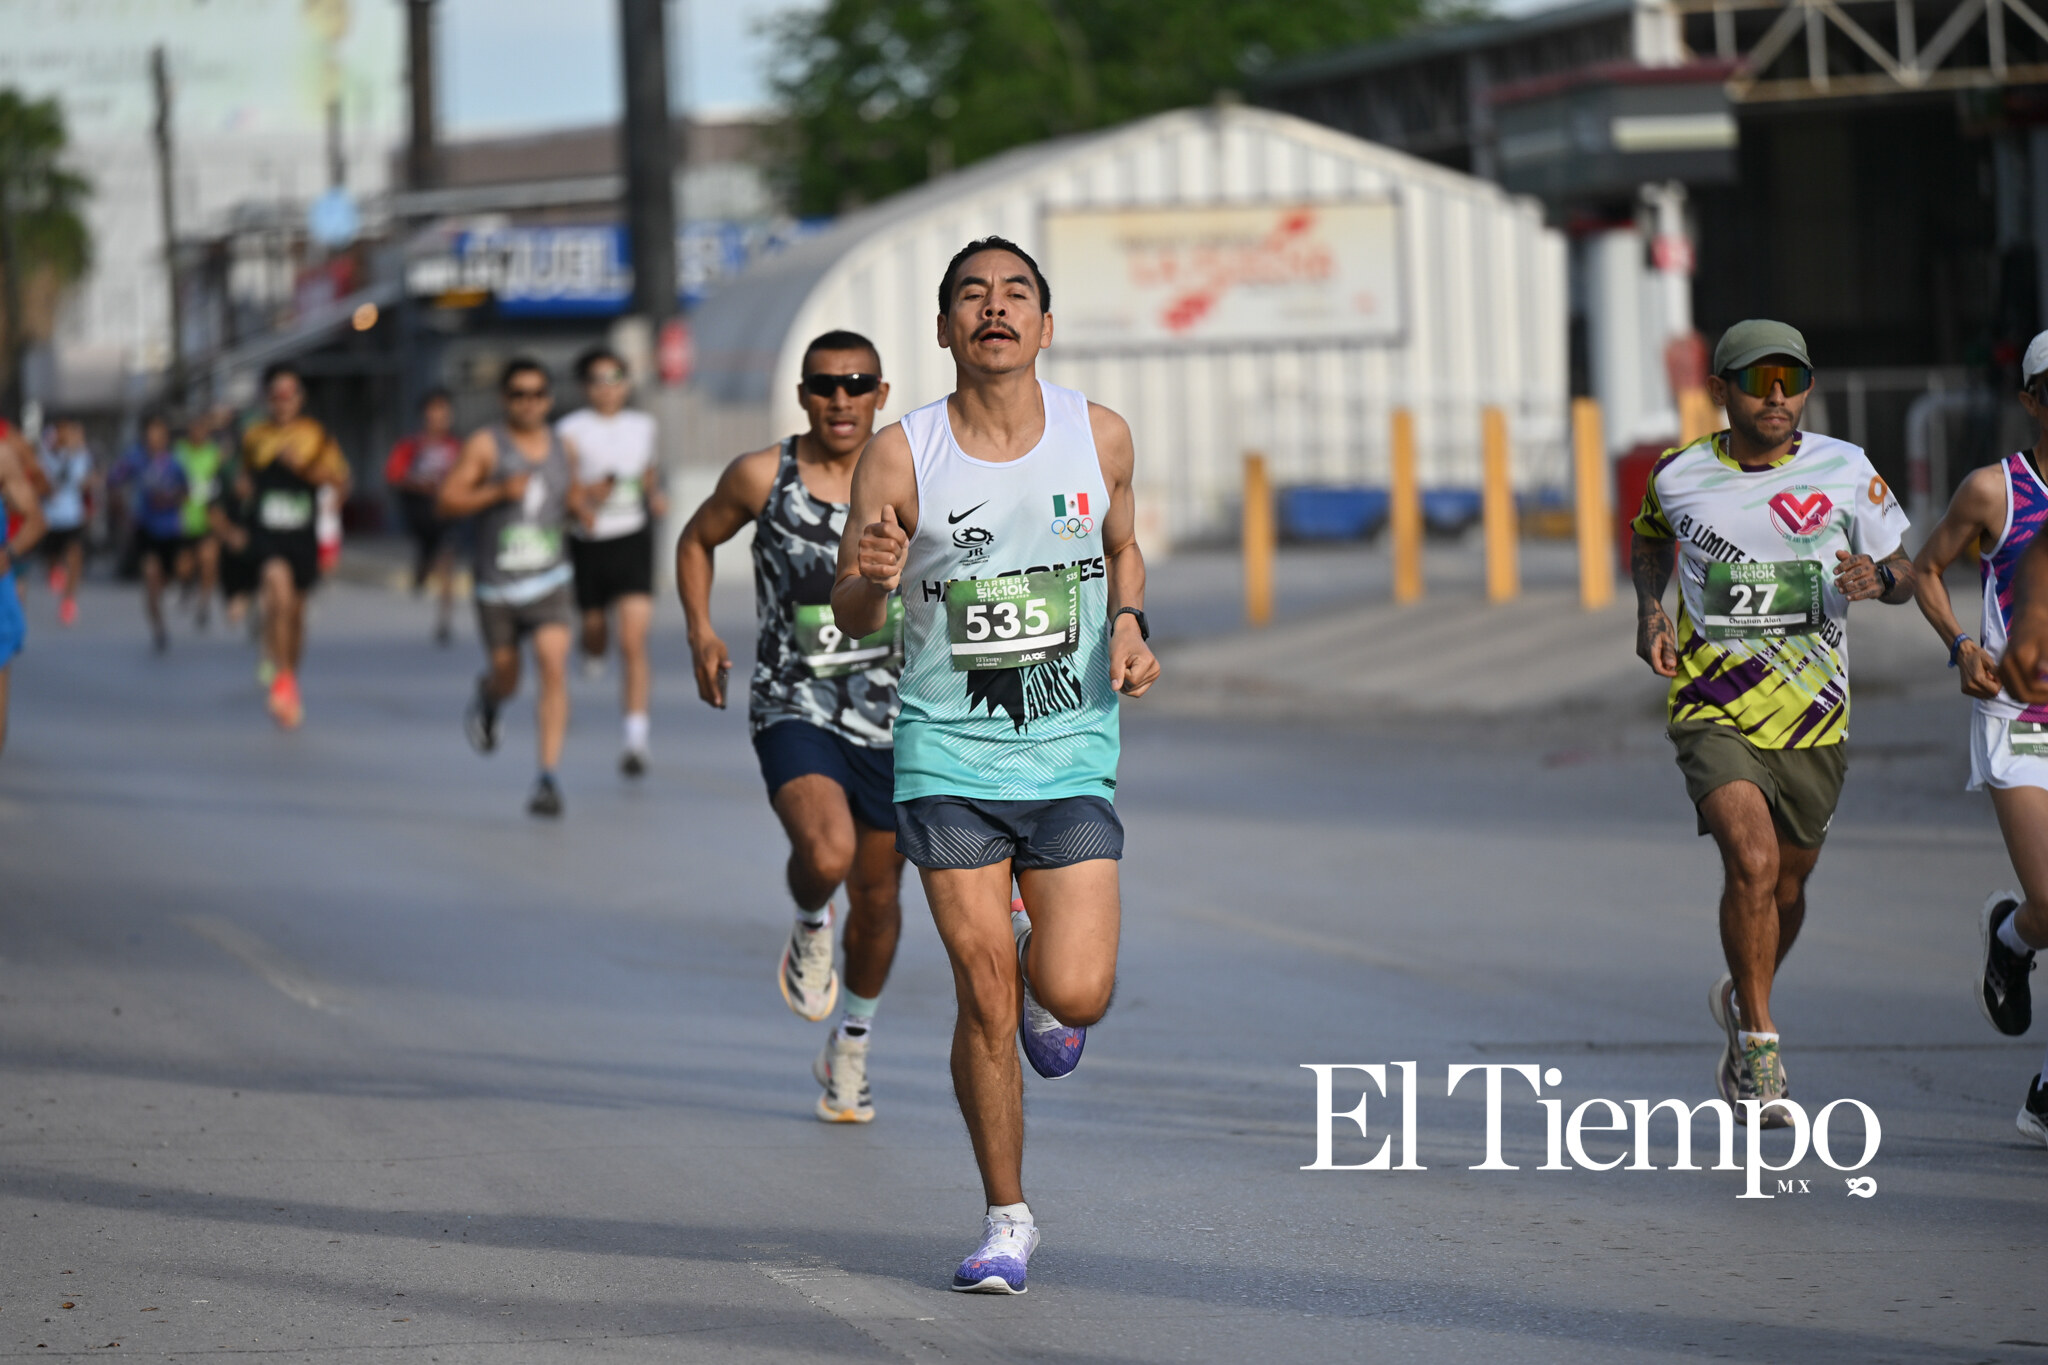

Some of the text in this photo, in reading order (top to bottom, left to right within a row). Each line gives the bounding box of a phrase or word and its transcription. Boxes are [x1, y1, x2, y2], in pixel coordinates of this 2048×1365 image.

[967, 547, 984, 559] JR
[1680, 514, 1746, 563] EL LÍMITE
[975, 576, 1030, 588] CARRERA
[1066, 571, 1078, 582] 535
[1730, 563, 1776, 571] CARRERA
[1068, 585, 1078, 644] MEDALLA
[1729, 583, 1779, 615] 27
[1811, 574, 1820, 625] MEDALLA
[966, 598, 1050, 641] 535
